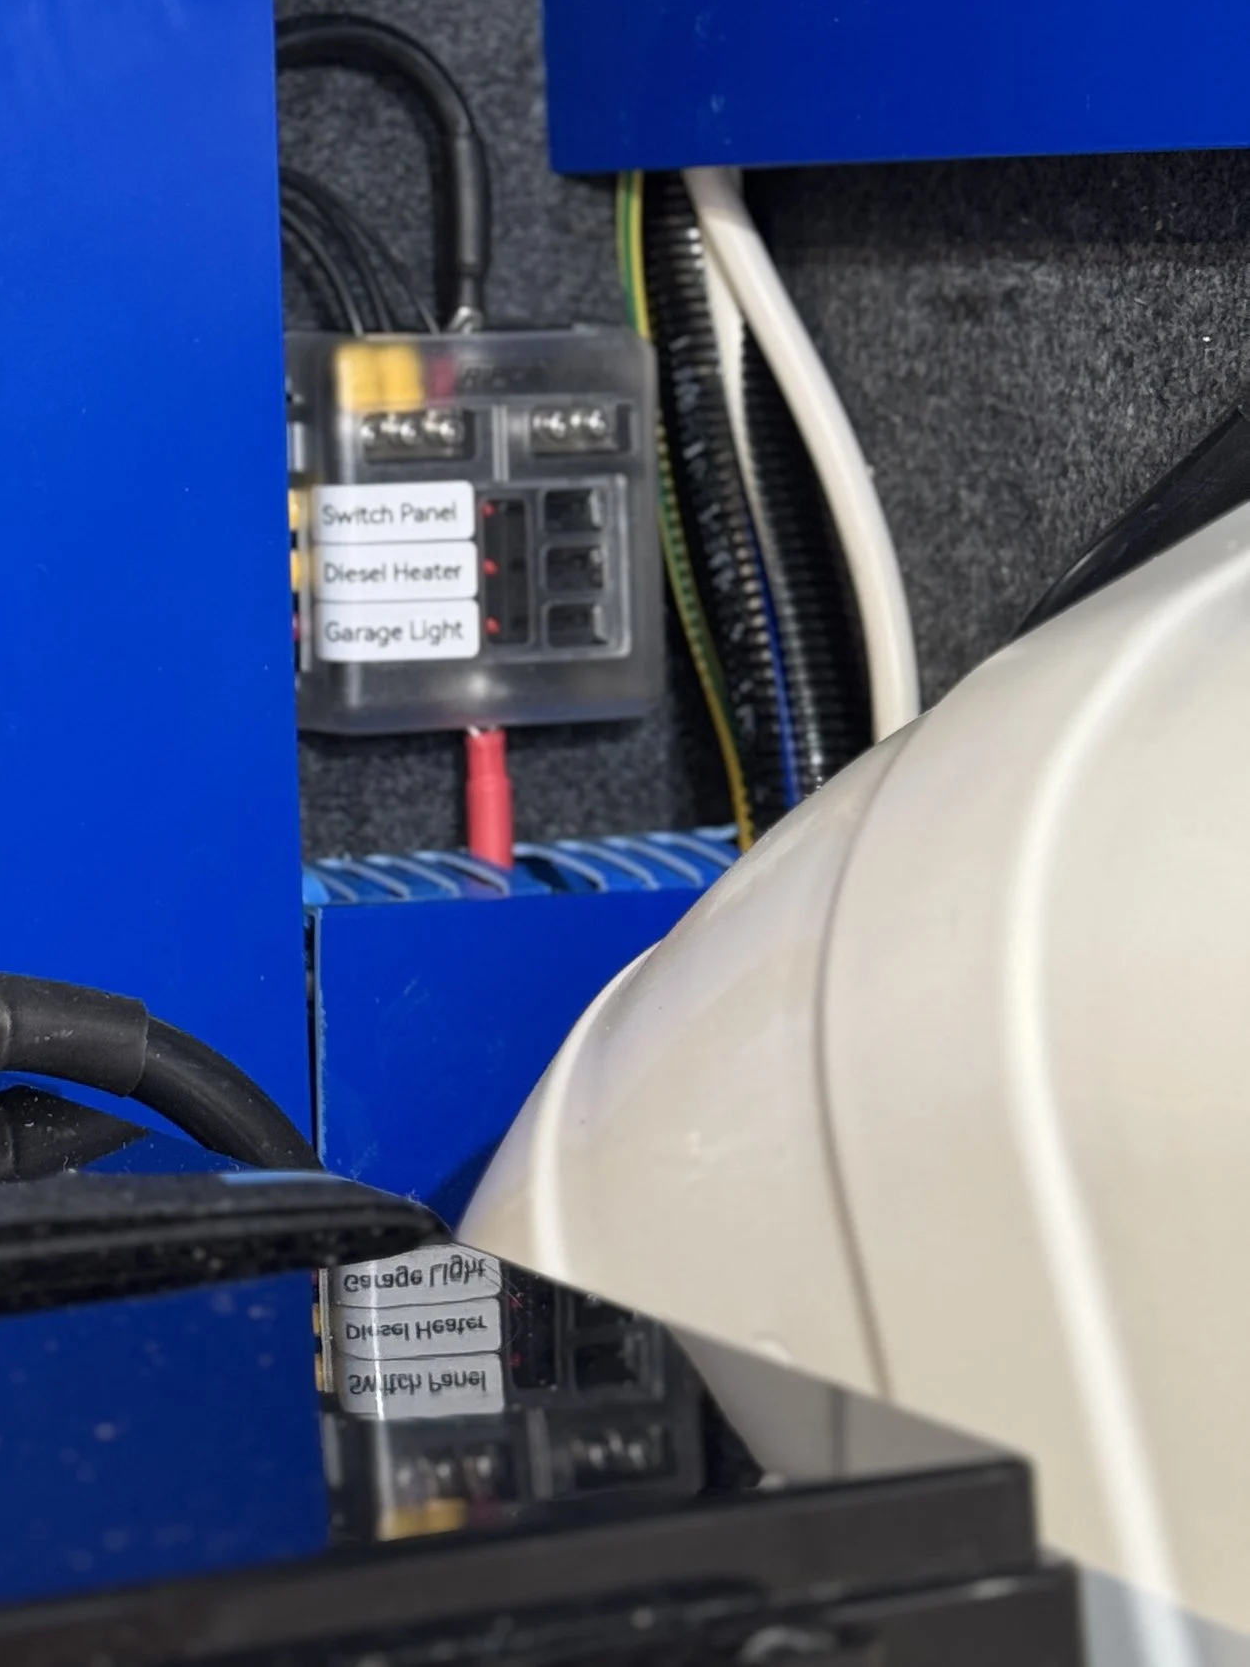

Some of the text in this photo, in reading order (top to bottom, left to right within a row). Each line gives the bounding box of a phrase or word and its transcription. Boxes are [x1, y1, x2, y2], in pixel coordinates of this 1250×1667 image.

[322, 502, 457, 525] Switch Panel
[324, 562, 462, 583] Diesel Heater
[326, 619, 463, 646] Garage Light
